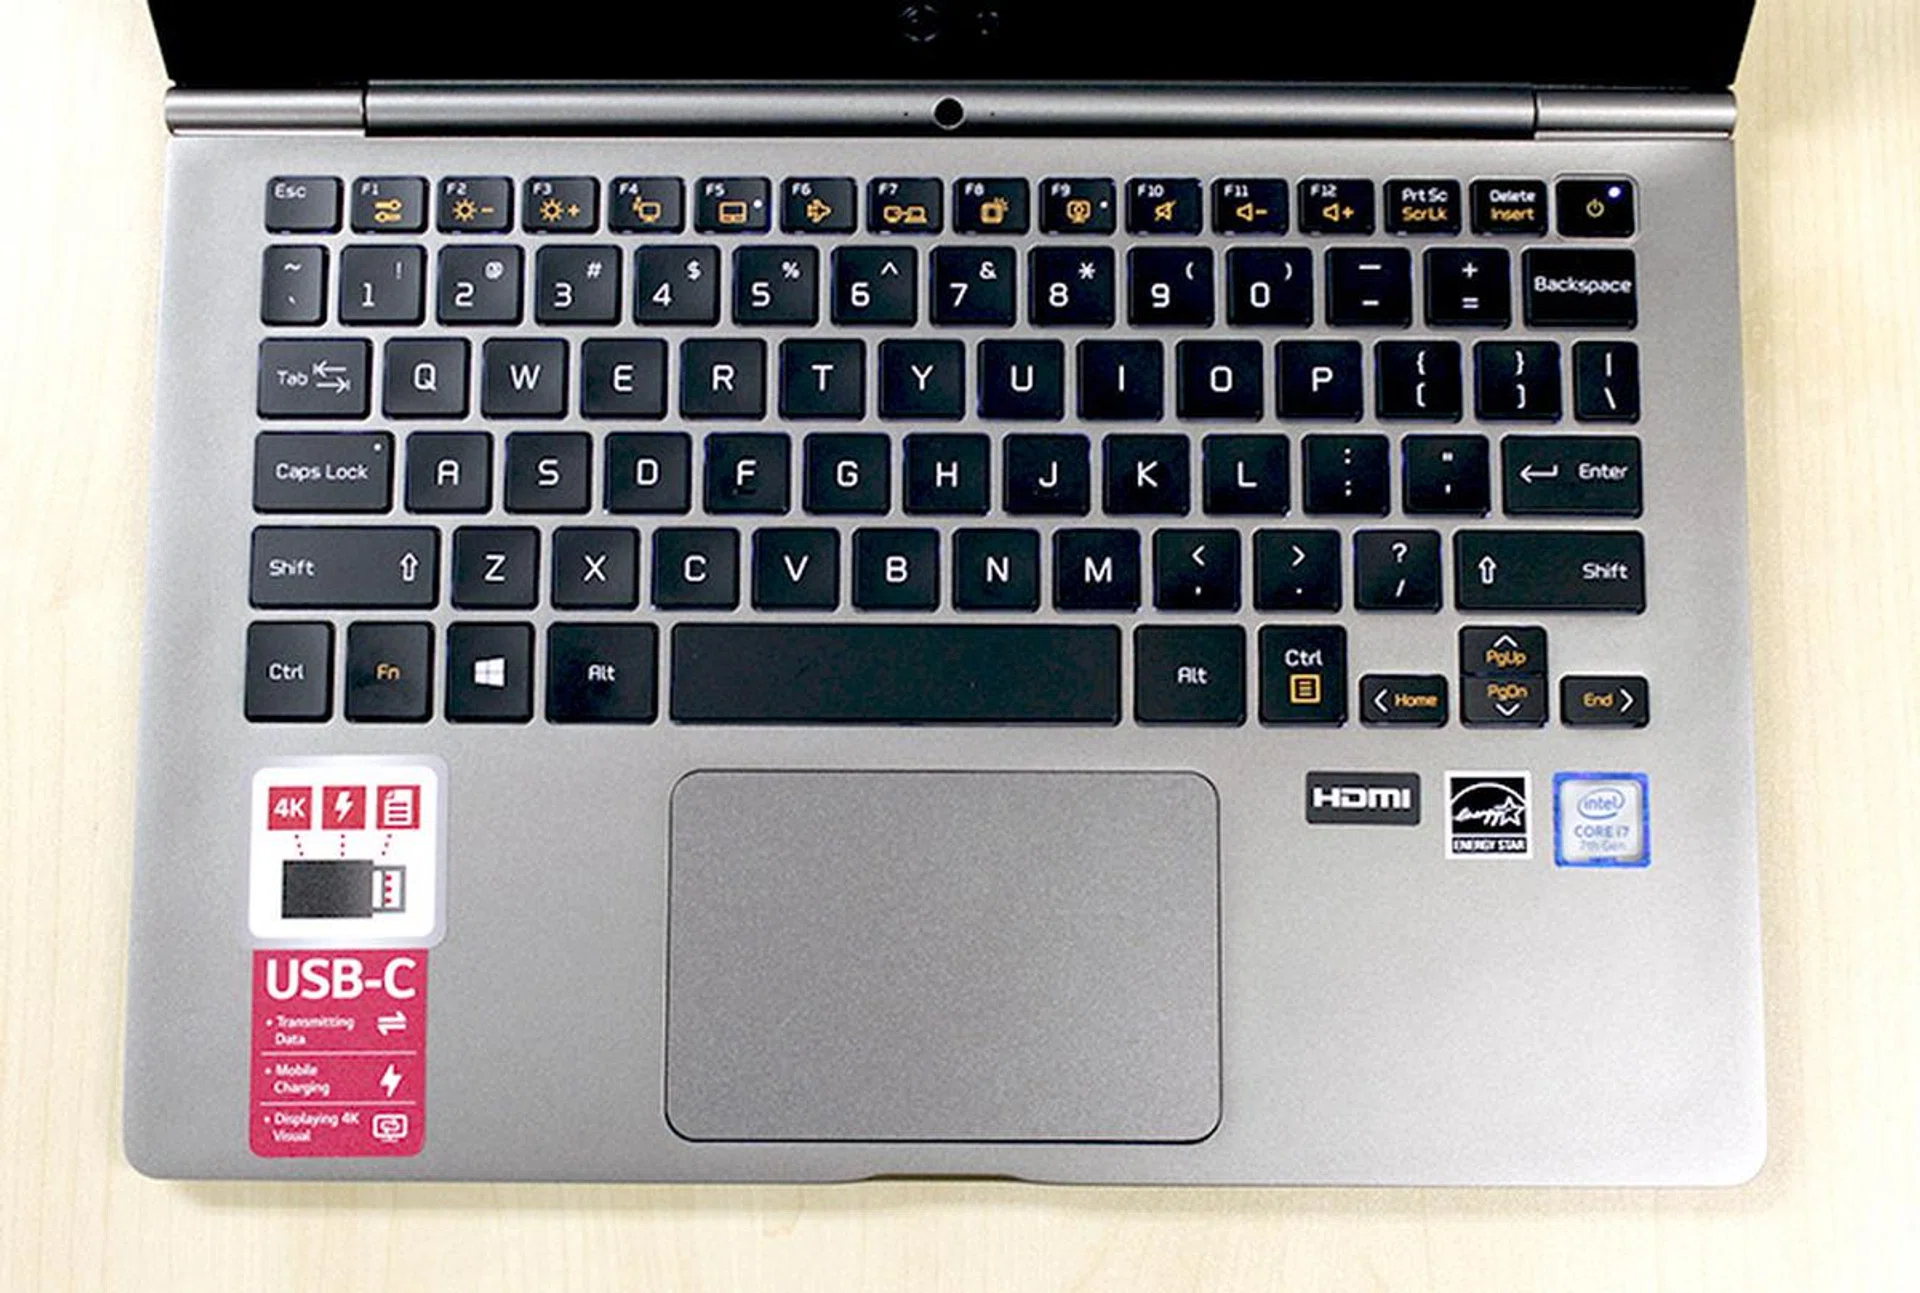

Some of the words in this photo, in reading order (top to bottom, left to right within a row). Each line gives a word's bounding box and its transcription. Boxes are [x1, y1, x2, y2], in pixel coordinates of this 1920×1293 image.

[275, 183, 306, 198] Esc
[361, 182, 379, 196] F1
[442, 182, 466, 196] F2
[533, 182, 552, 195] F3
[619, 182, 641, 197] F4
[706, 183, 727, 198] F5
[792, 182, 812, 196] F6
[879, 182, 898, 195] F7
[965, 182, 985, 197] F8
[1051, 182, 1071, 197] F9
[1138, 183, 1165, 198] F10
[1224, 184, 1249, 197] F11
[1310, 183, 1337, 198] F12
[1402, 187, 1426, 202] Prt
[1428, 187, 1448, 202] Sc
[1489, 189, 1536, 202] Delete
[1402, 206, 1447, 221] ScrLk
[1491, 207, 1534, 221] Insert
[396, 262, 401, 279] !
[485, 262, 504, 279] @
[587, 258, 602, 278] #
[687, 259, 704, 280] $
[782, 261, 800, 279] %
[881, 261, 898, 275] ^
[979, 261, 997, 279] &
[1186, 261, 1194, 280] (
[1285, 262, 1292, 281] )
[1462, 262, 1478, 278] +
[362, 282, 375, 307] 1
[455, 282, 474, 307] 2
[554, 282, 574, 308] 3
[652, 282, 672, 307] 4
[752, 282, 771, 307] 5
[851, 282, 870, 307] 6
[949, 283, 968, 307] 7
[1049, 282, 1069, 307] 8
[1250, 281, 1270, 308] 0
[1534, 276, 1632, 295] Backspace
[1150, 283, 1170, 308] 9
[1462, 297, 1479, 309] =
[1416, 351, 1426, 375] {
[1515, 350, 1524, 376] }
[277, 370, 308, 386] Tab
[414, 363, 436, 391] Q
[510, 364, 541, 390] W
[613, 365, 634, 392] E
[712, 364, 734, 391] R
[811, 364, 834, 391] T
[911, 365, 933, 391] Y
[1011, 365, 1033, 392] U
[1119, 365, 1124, 392] I
[1210, 365, 1233, 392] O
[1312, 366, 1333, 392] P
[1604, 387, 1616, 410] \
[1344, 448, 1351, 464] :
[276, 463, 322, 482] Caps
[325, 464, 368, 480] Lock
[437, 459, 459, 485] A
[538, 459, 559, 486] S
[637, 458, 658, 485] D
[737, 459, 757, 486] F
[837, 460, 858, 487] G
[936, 461, 958, 487] H
[1039, 461, 1057, 488] J
[1137, 461, 1158, 487] K
[1237, 461, 1258, 488] L
[1578, 463, 1628, 480] Enter
[1345, 480, 1352, 496] ;
[1192, 545, 1205, 566] <
[1292, 545, 1305, 566] >
[1392, 542, 1407, 563] ?
[269, 559, 314, 576] Shift
[483, 554, 505, 581] Z
[584, 555, 608, 582] X
[684, 555, 706, 582] C
[784, 555, 809, 582] V
[886, 556, 908, 583] B
[987, 556, 1009, 582] N
[1085, 556, 1112, 583] M
[1582, 562, 1628, 579] Shift
[1395, 579, 1405, 597] /
[1285, 649, 1323, 667] Ctrl
[1486, 649, 1527, 667] PgUp
[269, 663, 303, 680] Ctrl
[377, 664, 400, 679] Fn
[588, 664, 615, 681] Alt
[1178, 666, 1207, 684] Alt
[1395, 693, 1438, 707] Home
[1584, 691, 1613, 707] End
[1313, 788, 1411, 809] HDMI
[1584, 798, 1618, 811] intel
[274, 798, 306, 819] 4K
[1575, 825, 1612, 838] CORE
[1617, 824, 1630, 837] i7
[1454, 841, 1495, 851] ENERGY
[1498, 840, 1526, 850] STAR
[1602, 841, 1627, 851] Gen
[265, 957, 417, 1000] USB-C
[276, 1015, 355, 1031] Transmitting
[275, 1033, 306, 1046] Data
[275, 1063, 318, 1076] Mobile
[273, 1081, 331, 1096] Charging
[274, 1112, 339, 1128] Displaying
[341, 1112, 360, 1124] 4K
[273, 1129, 311, 1142] Visual
